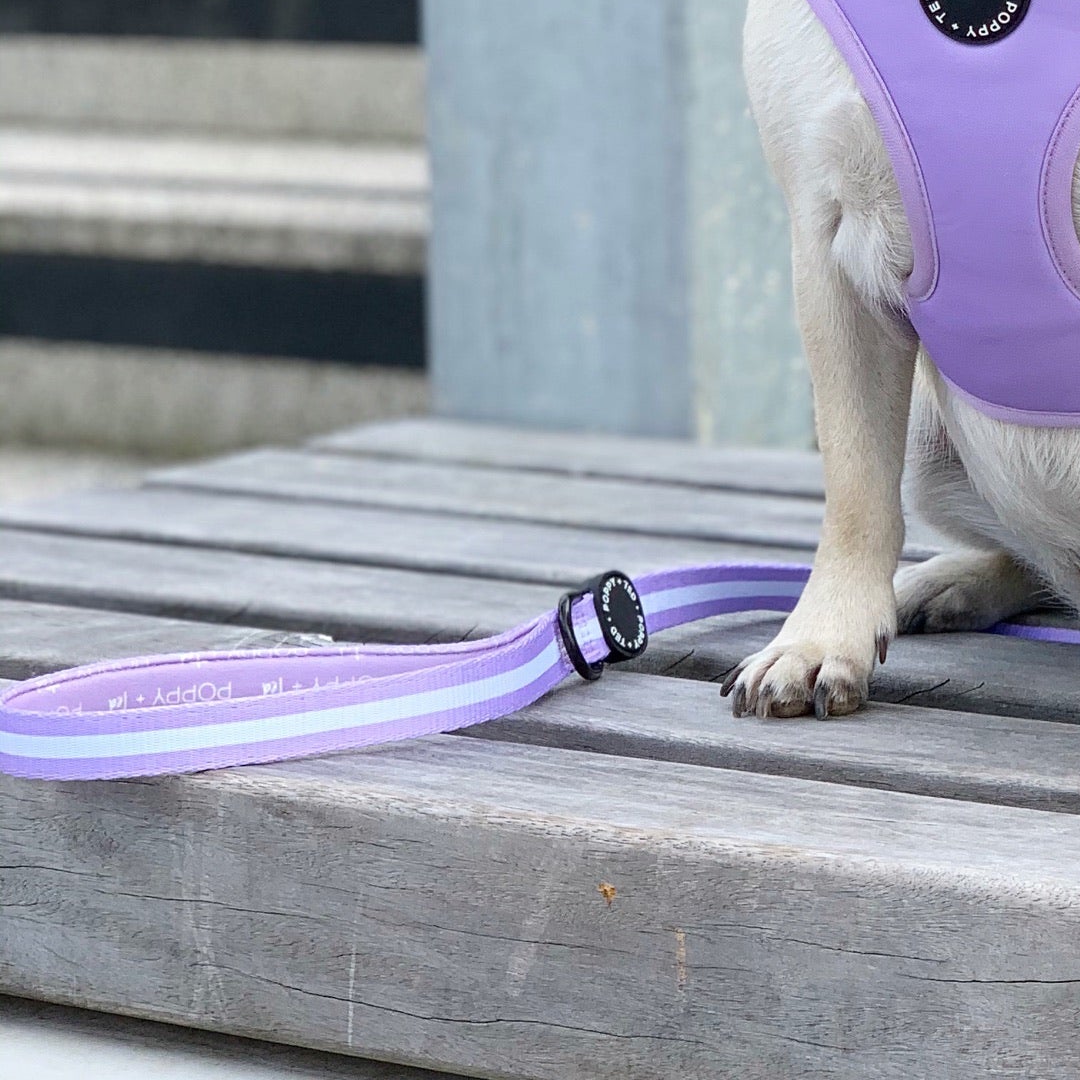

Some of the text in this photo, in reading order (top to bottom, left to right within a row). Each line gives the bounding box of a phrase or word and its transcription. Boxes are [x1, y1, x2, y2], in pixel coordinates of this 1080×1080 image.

[966, 1, 1018, 37] POPPY
[602, 577, 616, 612] POPPY
[623, 580, 637, 601] TED
[610, 626, 626, 648] TED
[152, 681, 232, 706] POPPY
